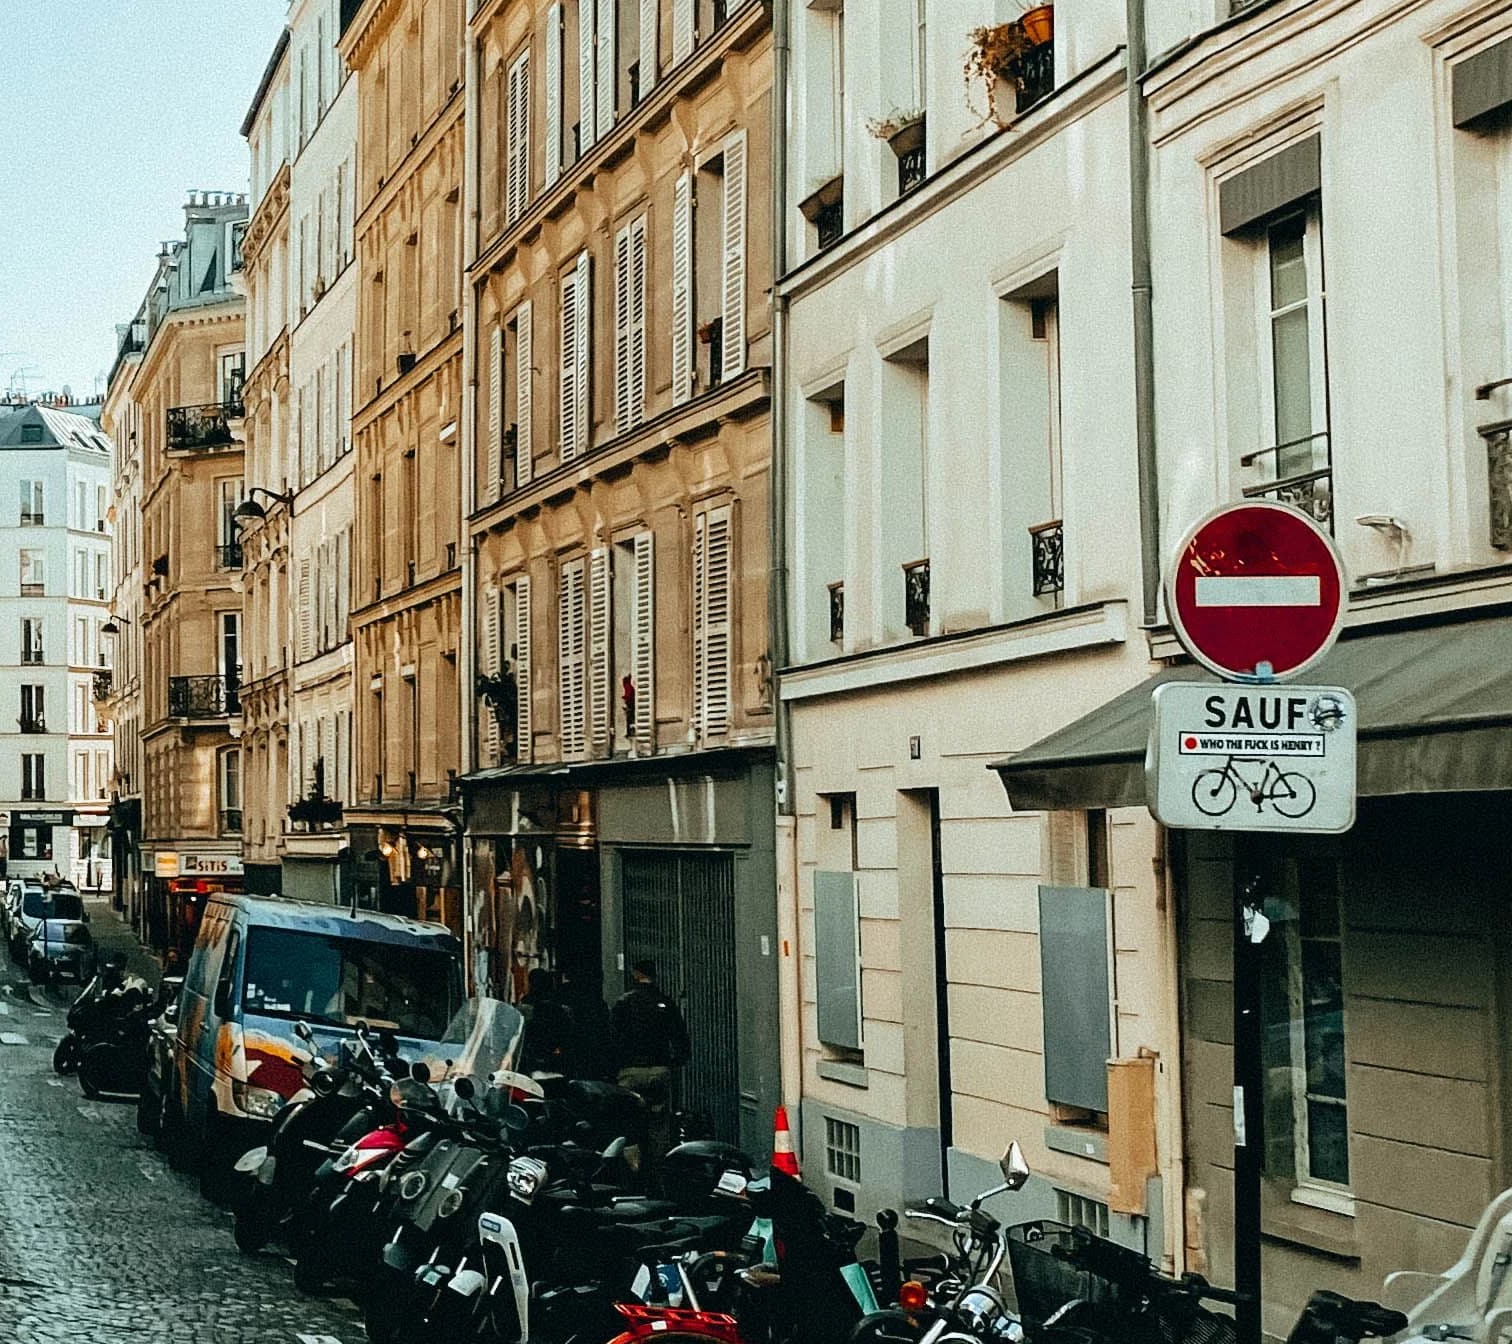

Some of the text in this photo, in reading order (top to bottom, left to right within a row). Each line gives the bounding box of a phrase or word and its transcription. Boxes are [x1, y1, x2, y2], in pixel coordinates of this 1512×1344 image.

[1204, 695, 1307, 730] SAUF
[1200, 739, 1223, 749] WHO
[1226, 740, 1242, 750] THE
[1244, 740, 1268, 750] FUCK
[1271, 740, 1279, 750] IS
